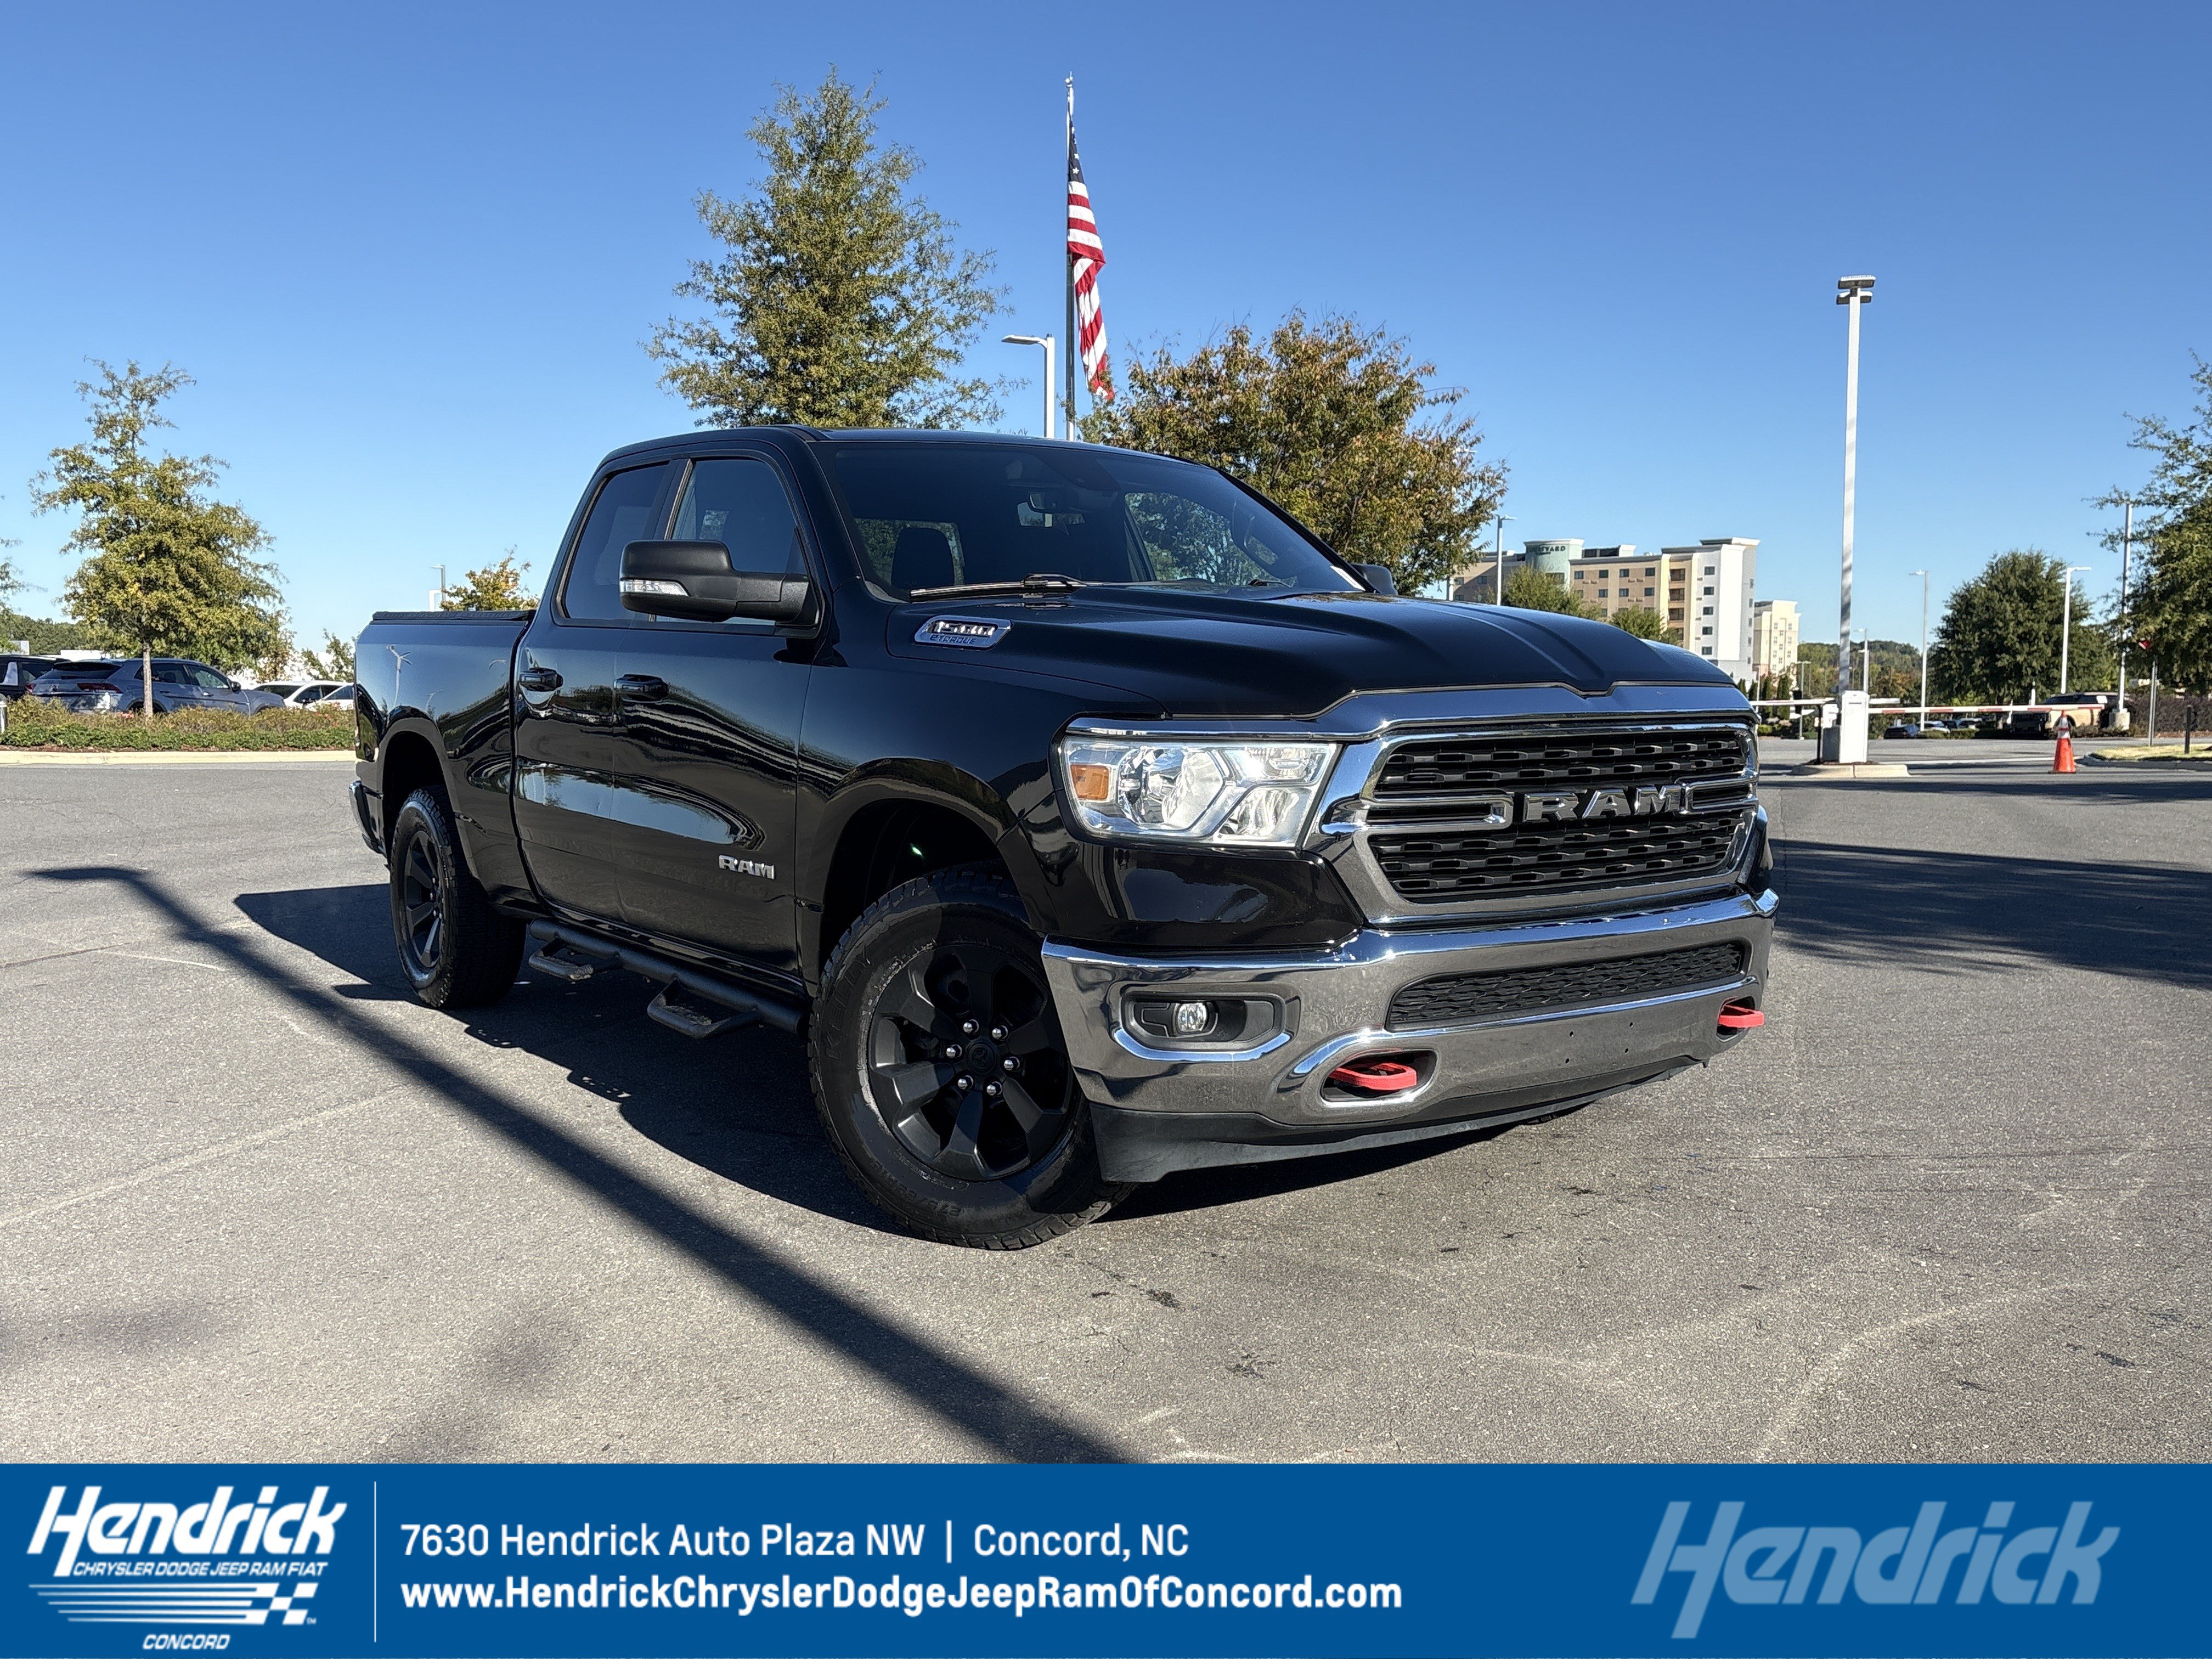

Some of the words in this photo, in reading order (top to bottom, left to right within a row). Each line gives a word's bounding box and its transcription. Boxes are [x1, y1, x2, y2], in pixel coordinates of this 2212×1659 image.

[1523, 785, 1682, 822] RAM
[719, 854, 776, 880] RAM
[825, 947, 872, 1061] KELLY
